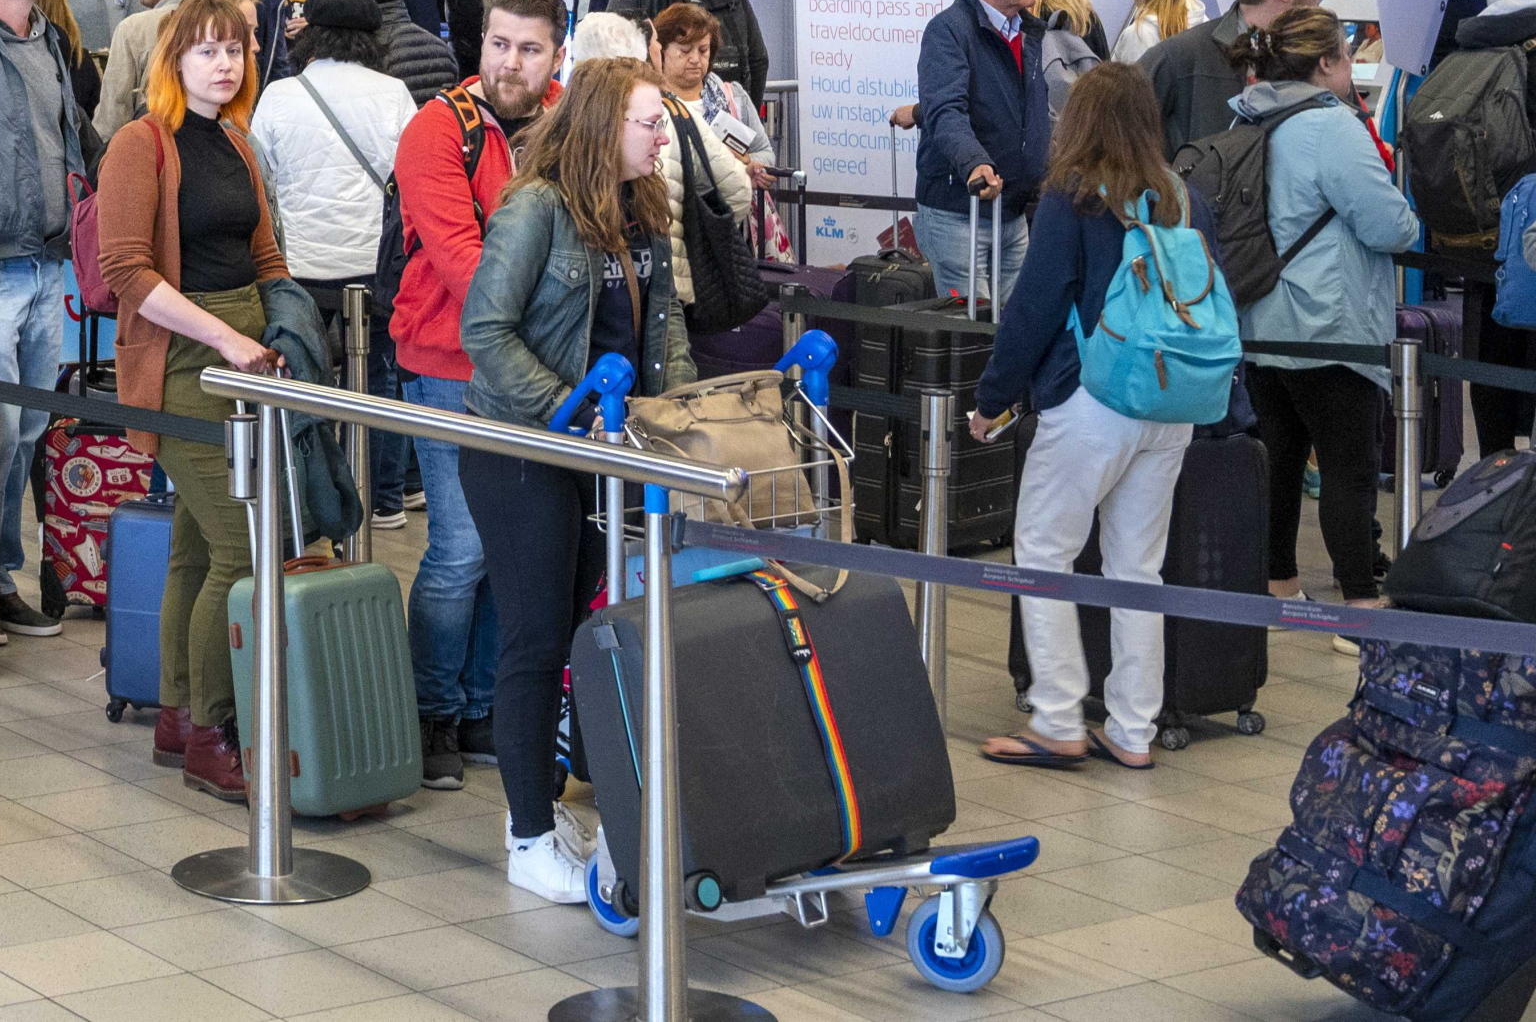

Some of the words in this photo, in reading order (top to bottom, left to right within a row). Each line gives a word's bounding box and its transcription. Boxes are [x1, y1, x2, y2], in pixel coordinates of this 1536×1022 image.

[876, 0, 910, 18] pass
[810, 49, 853, 70] ready
[811, 75, 851, 94] Houd
[811, 104, 833, 120] uw
[813, 156, 867, 176] gereed
[816, 226, 844, 238] KLM
